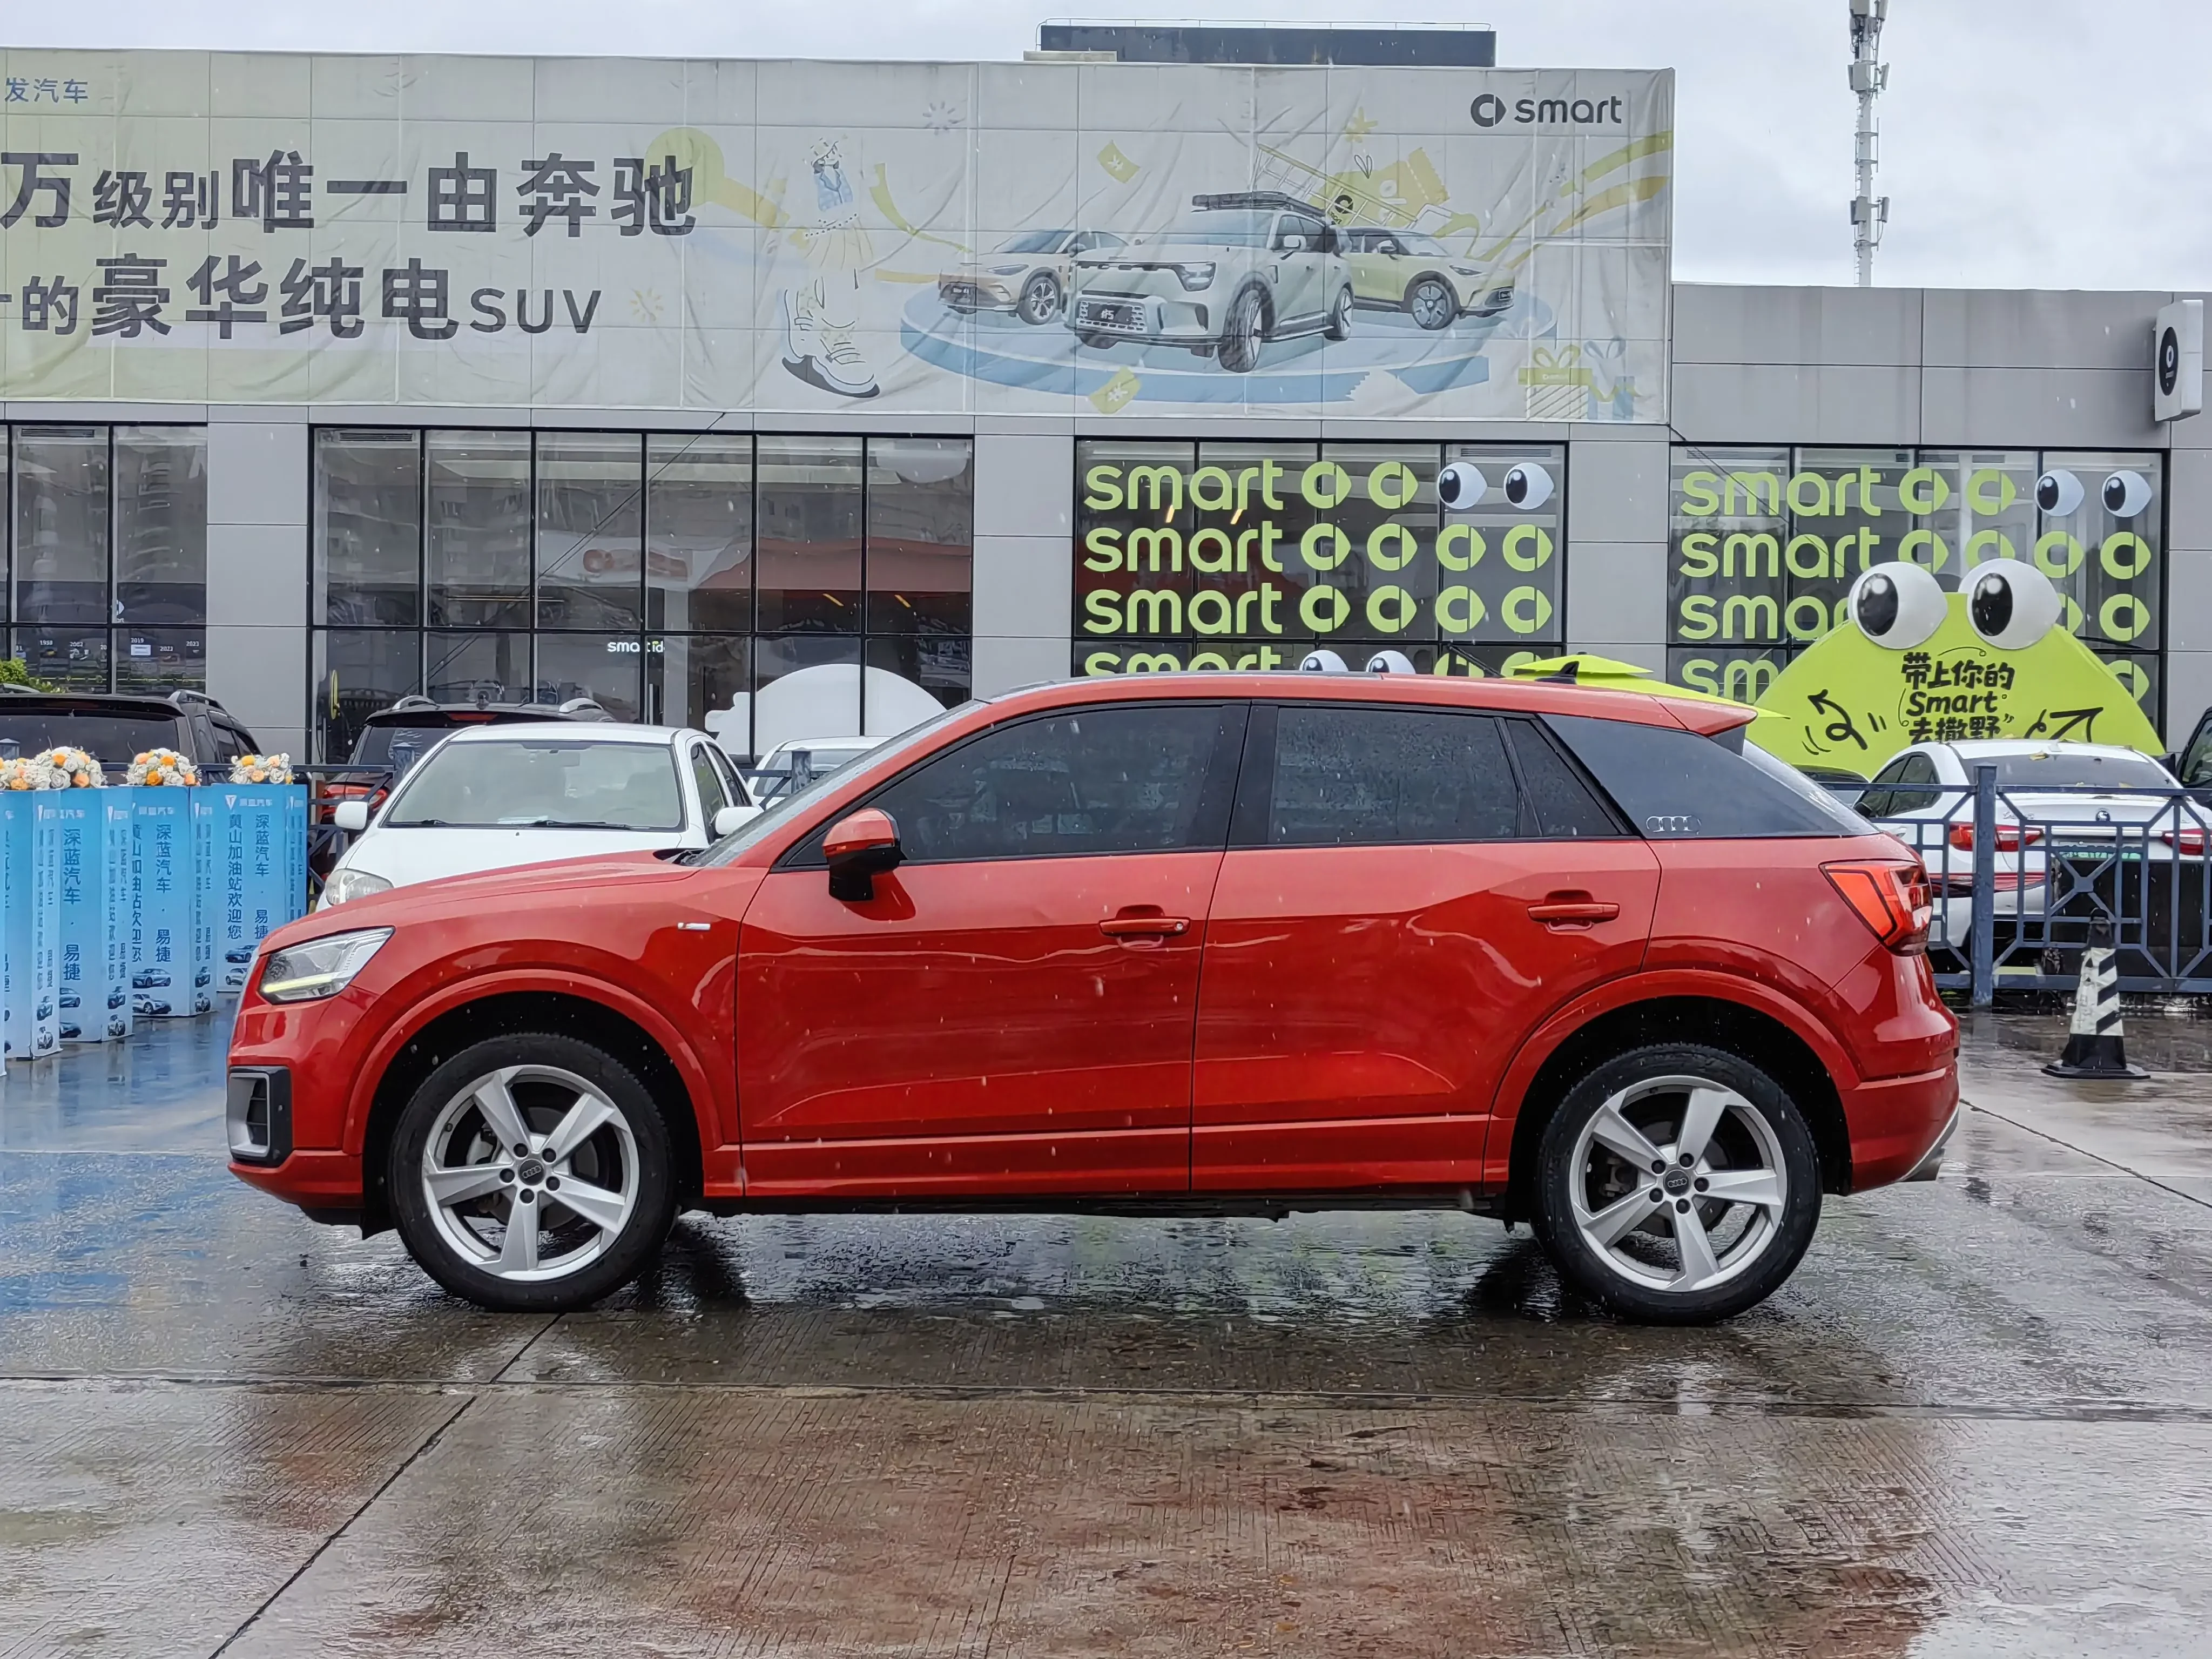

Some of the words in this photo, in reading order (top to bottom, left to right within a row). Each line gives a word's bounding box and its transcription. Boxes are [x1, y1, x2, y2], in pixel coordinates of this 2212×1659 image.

[1514, 96, 1622, 124] smart
[1084, 459, 1284, 510] smart
[1681, 464, 1881, 516] smart
[1083, 521, 1283, 572] smart
[1679, 527, 1880, 578] smart
[1083, 583, 1283, 634] smart
[1901, 652, 2015, 690] 带上你的
[1906, 691, 1998, 716] Smart
[63, 828, 81, 905] 深蓝汽车
[156, 824, 172, 894] 深蓝汽车
[255, 814, 269, 877] 深蓝汽车
[63, 944, 81, 981] 易捷
[156, 929, 172, 962] 易捷
